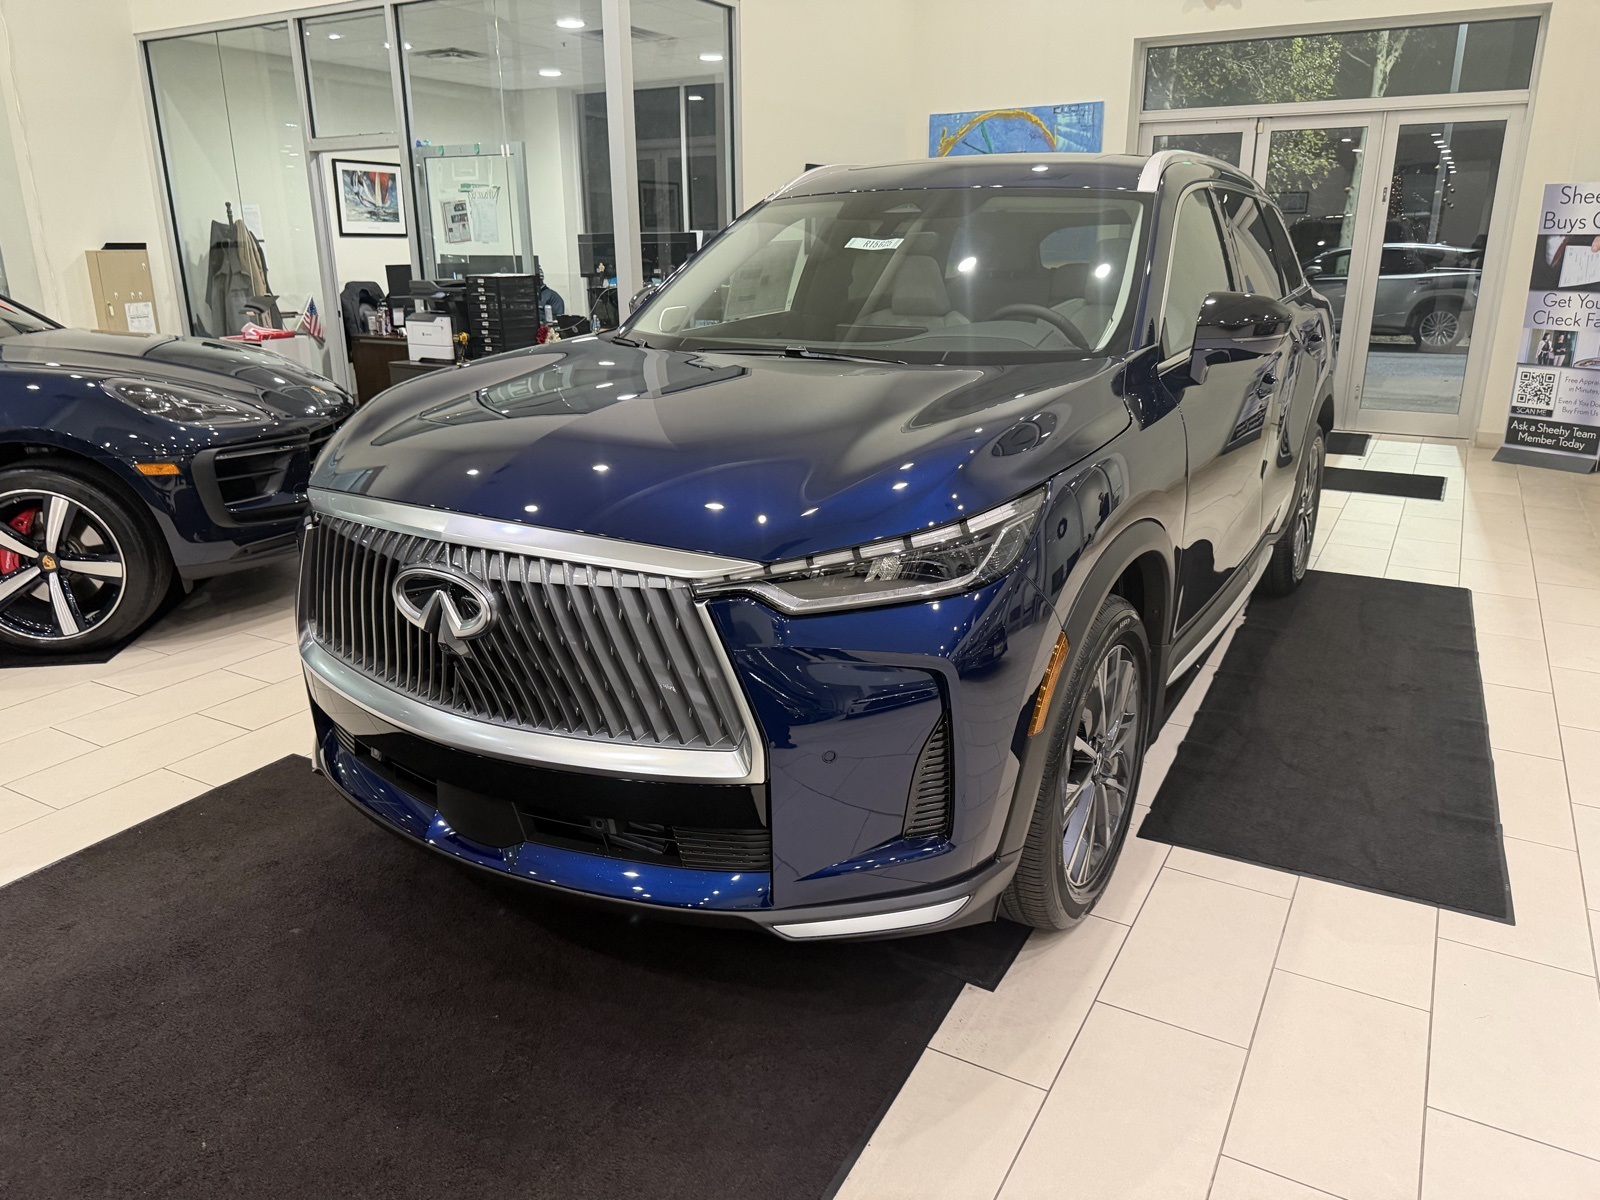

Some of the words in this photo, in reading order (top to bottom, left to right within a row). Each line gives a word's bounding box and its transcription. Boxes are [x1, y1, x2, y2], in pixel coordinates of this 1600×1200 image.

[1543, 211, 1586, 233] Buys
[1543, 292, 1572, 308] Get
[1532, 310, 1581, 327] Check
[1564, 376, 1578, 384] Free
[1558, 397, 1572, 405] Even
[1579, 399, 1589, 407] You
[1516, 406, 1536, 415] SCAN
[1536, 408, 1547, 416] ME
[1562, 406, 1573, 414] Buy
[1574, 407, 1589, 415] From
[1511, 420, 1528, 431] Ask
[1537, 423, 1571, 438] Sheehy
[1573, 426, 1597, 439] Team
[1518, 431, 1557, 446] Member
[1559, 437, 1586, 451] Today
